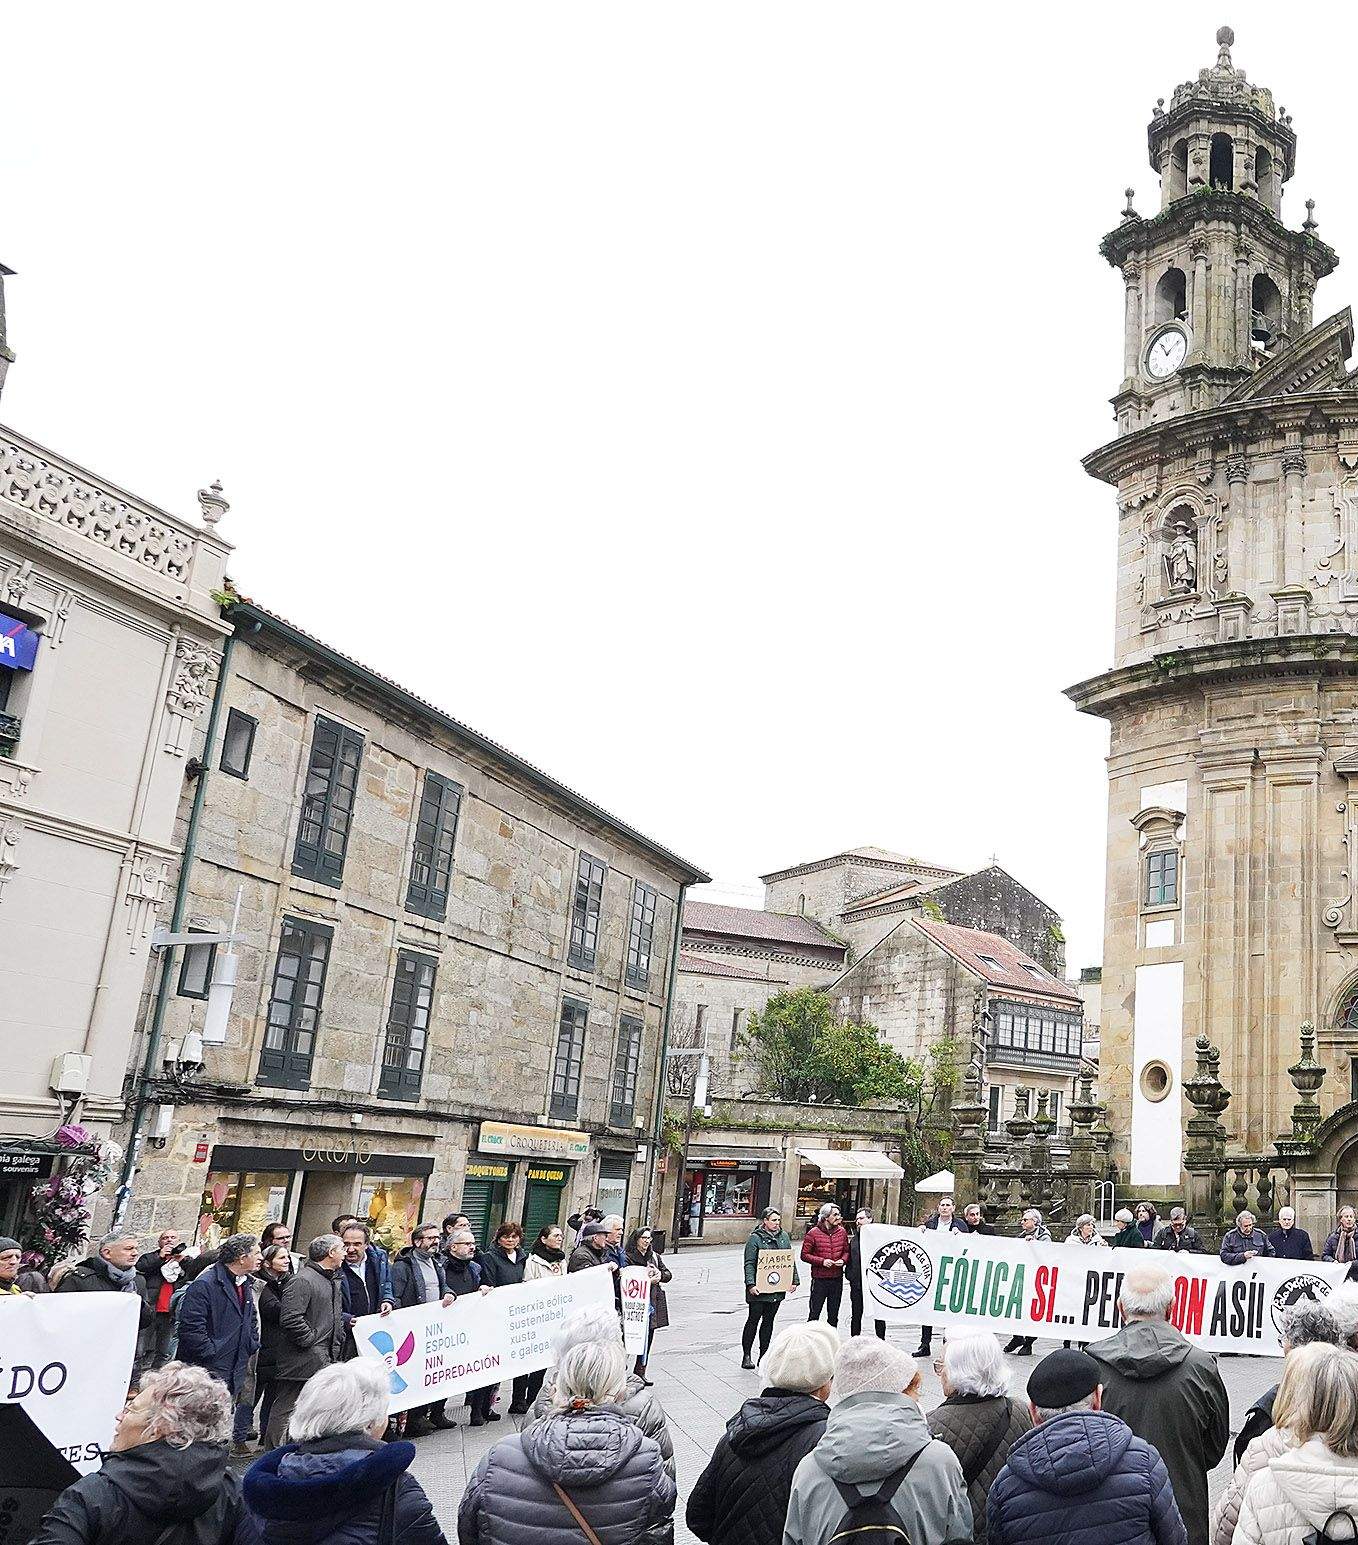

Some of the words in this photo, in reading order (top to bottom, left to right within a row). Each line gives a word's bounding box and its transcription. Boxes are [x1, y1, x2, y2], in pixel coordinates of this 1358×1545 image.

[12, 1154, 40, 1166] galega
[933, 1248, 1026, 1320] EÓLICA
[1209, 1271, 1265, 1339] ASÍ!
[425, 1322, 443, 1337] NIN
[425, 1332, 469, 1354] ESPOLIO,
[510, 1331, 537, 1345] xusta
[425, 1354, 444, 1370] NIN
[510, 1350, 516, 1359] e
[424, 1353, 500, 1387] DEPREDACIÓN
